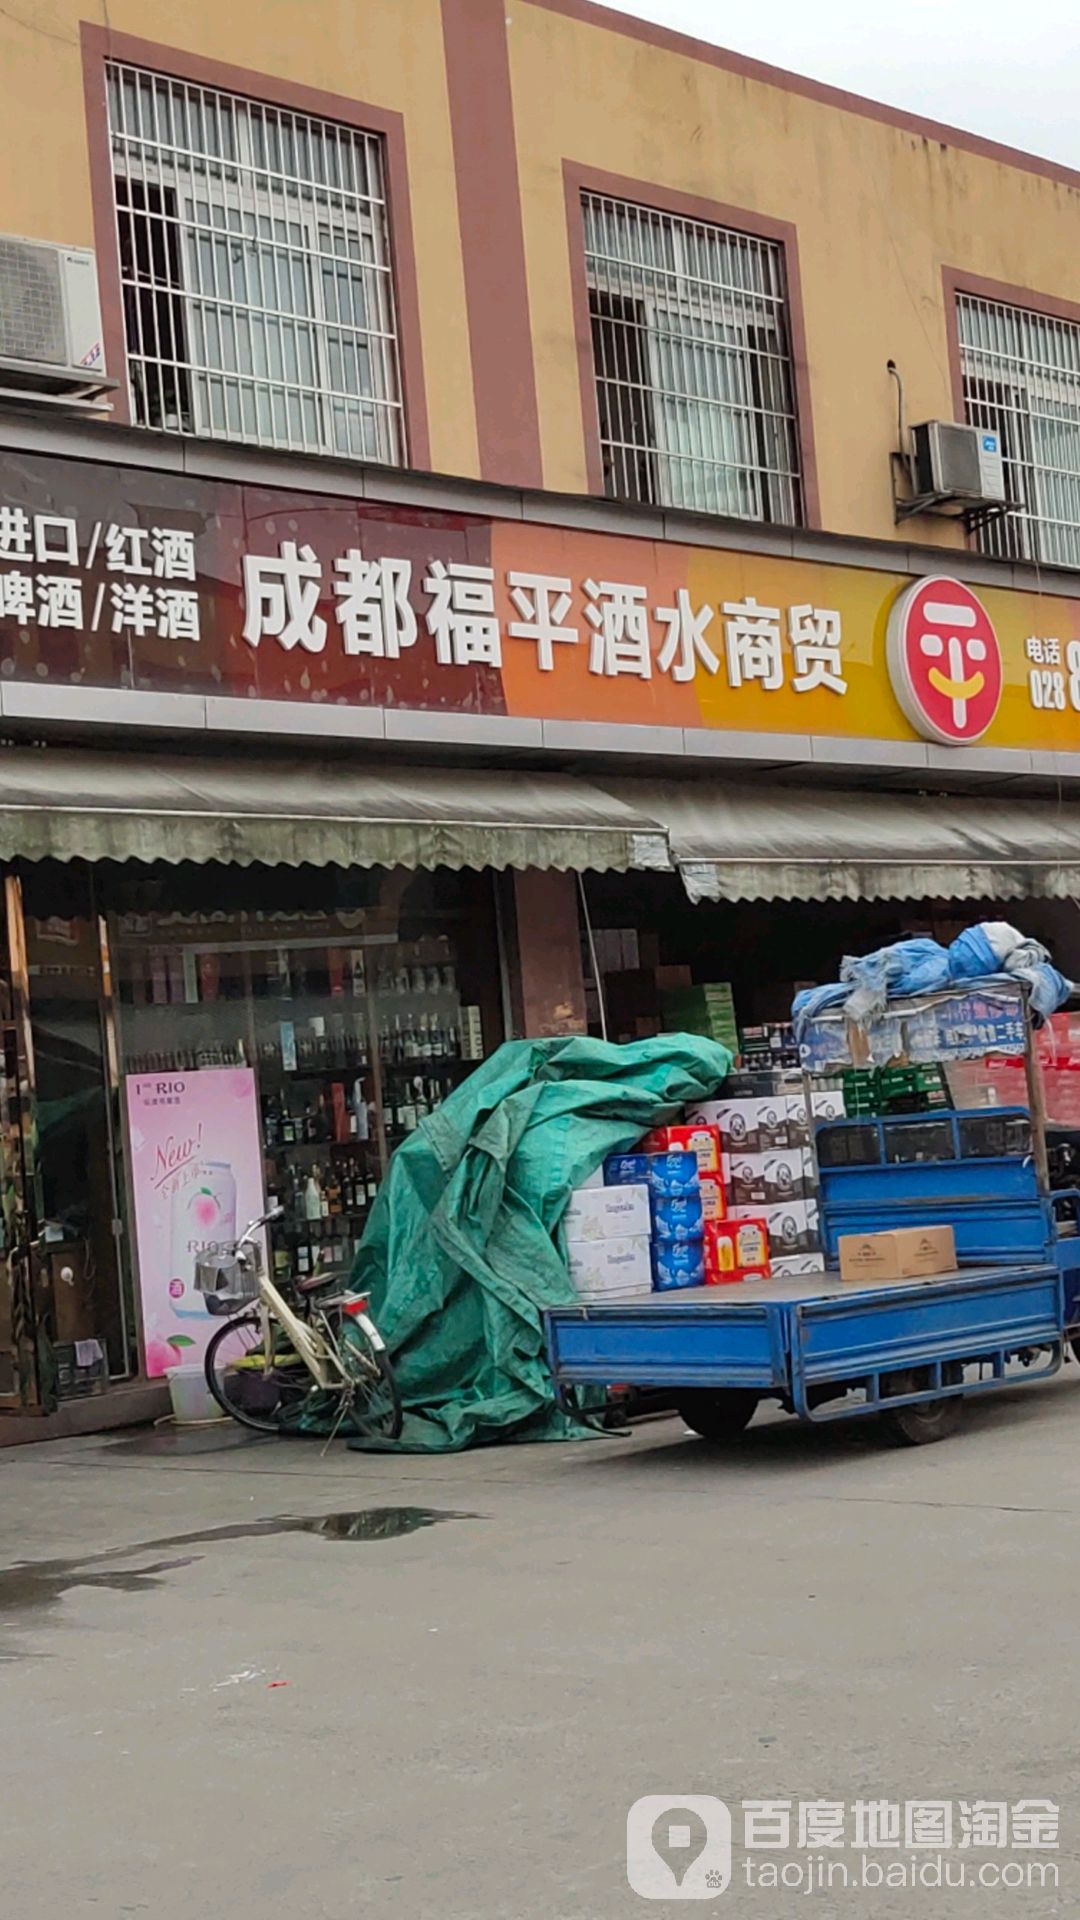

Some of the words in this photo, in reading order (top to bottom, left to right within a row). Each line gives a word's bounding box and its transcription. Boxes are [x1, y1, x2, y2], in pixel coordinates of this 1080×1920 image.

[242, 540, 848, 696] 成都福平酒水商贸
[1025, 635, 1061, 666] 电话
[1029, 669, 1065, 710] 028
[155, 1081, 186, 1095] RIO
[150, 1122, 202, 1182] New!
